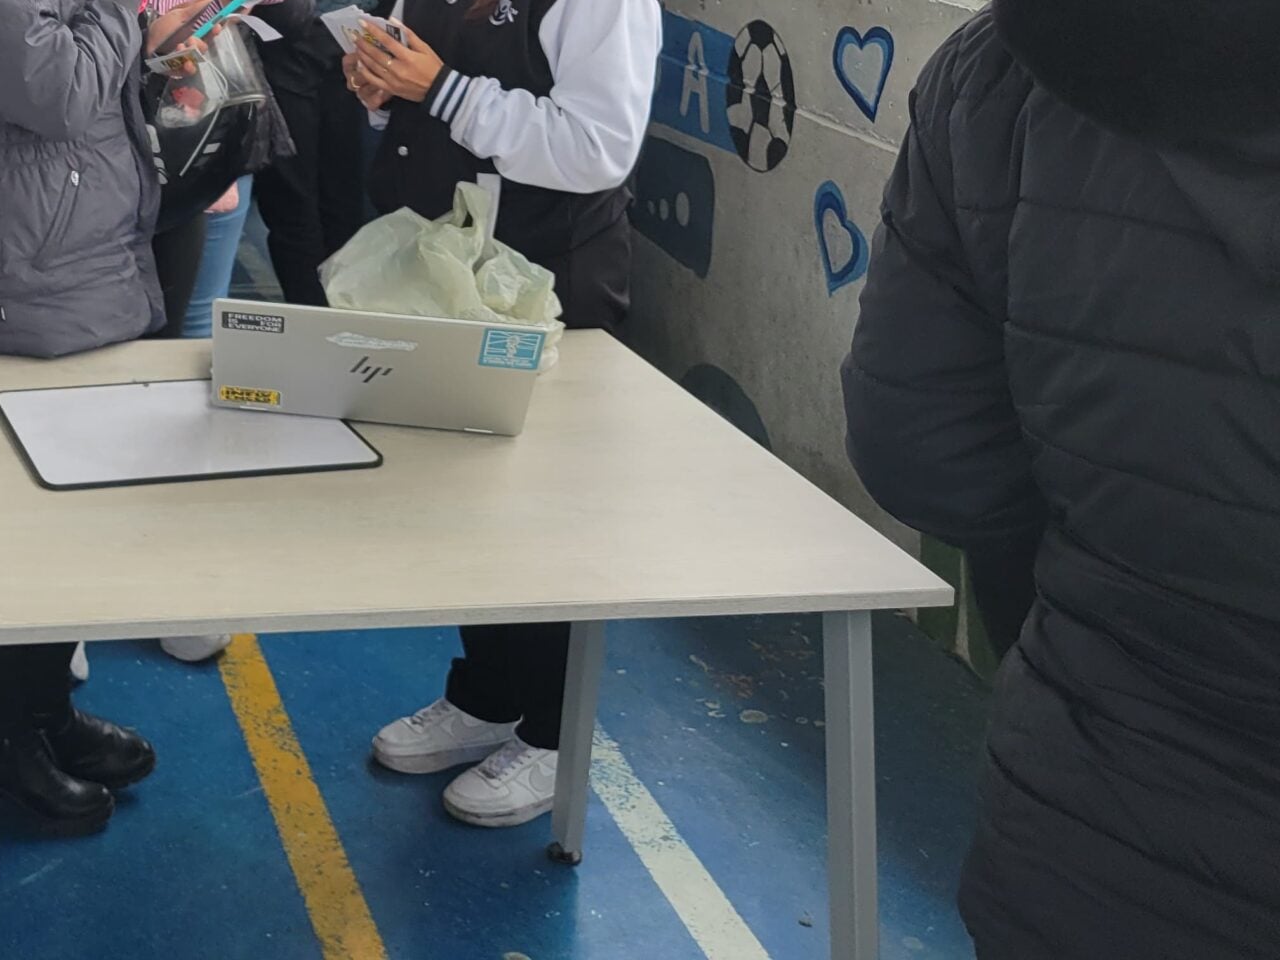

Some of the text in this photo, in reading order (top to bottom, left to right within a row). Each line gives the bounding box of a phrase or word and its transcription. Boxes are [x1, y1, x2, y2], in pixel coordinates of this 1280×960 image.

[228, 313, 282, 322] FREEDOM
[228, 323, 281, 332] EVERYONE
[350, 356, 393, 383] hp
